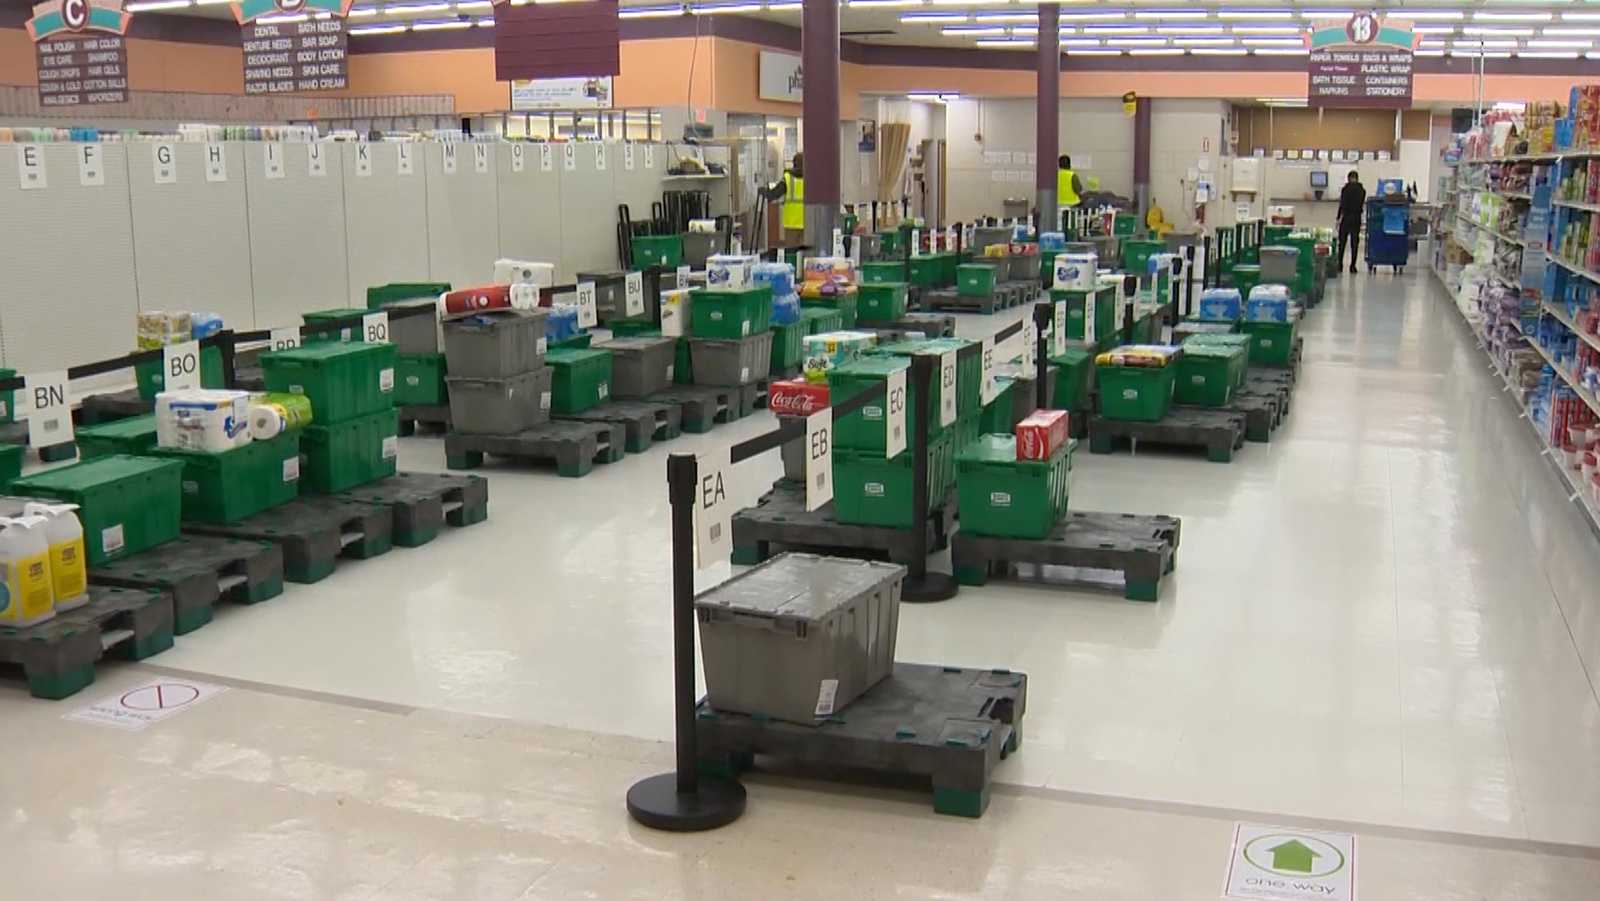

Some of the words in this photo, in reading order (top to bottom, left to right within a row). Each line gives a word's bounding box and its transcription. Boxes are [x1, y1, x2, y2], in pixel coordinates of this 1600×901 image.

[66, 0, 84, 25] C
[255, 26, 279, 36] DENTAL
[298, 23, 316, 33] BATH
[317, 21, 341, 32] NEEDS
[1352, 16, 1371, 42] 13
[54, 42, 76, 51] POLISH
[99, 39, 120, 48] COLOR
[244, 40, 271, 52] DENTURE
[272, 39, 292, 49] NEEDS
[302, 38, 316, 47] BAR
[319, 36, 338, 46] SOAP
[56, 54, 73, 64] CARE
[88, 52, 118, 62] SHAMPOO
[248, 53, 288, 64] DEODORANT
[297, 51, 316, 62] BODY
[318, 50, 344, 60] LOTION
[1310, 54, 1331, 62] PAPER
[1333, 54, 1359, 62] TOWELS
[272, 67, 293, 77] NEEDS
[302, 66, 319, 76] SKIN
[320, 64, 340, 74] CARE
[1361, 64, 1389, 73] PLASTIC
[1391, 64, 1411, 73] WRAP
[83, 80, 107, 90] COTTON
[108, 78, 126, 88] BALLS
[298, 80, 318, 89] HAND
[319, 78, 345, 88] CREAM
[1312, 76, 1330, 84] BATH
[1332, 75, 1355, 84] TISSUE
[1365, 76, 1408, 85] CONTAINERS
[246, 82, 268, 93] RAZOR
[269, 81, 294, 91] BLADES
[1319, 87, 1348, 96] NAPKINS
[1366, 87, 1406, 96] STATIONERY
[24, 147, 36, 166] E
[84, 146, 93, 164] F
[158, 146, 170, 164] G
[209, 146, 220, 163] H
[312, 144, 318, 159] J
[359, 145, 367, 160] K
[400, 144, 406, 159] L
[446, 145, 454, 157] M
[477, 145, 484, 156] N
[514, 145, 521, 157] O
[543, 145, 549, 156] P
[628, 280, 641, 294] BU
[580, 290, 592, 305] BT
[368, 323, 386, 342] BQ
[171, 353, 196, 377] BO
[984, 349, 992, 371] EE
[944, 365, 954, 388] ED
[34, 384, 64, 409] BN
[891, 387, 903, 415] EC
[811, 428, 828, 460] EB
[703, 471, 725, 509] EA
[1246, 878, 1285, 887] one
[1292, 881, 1336, 895] way
